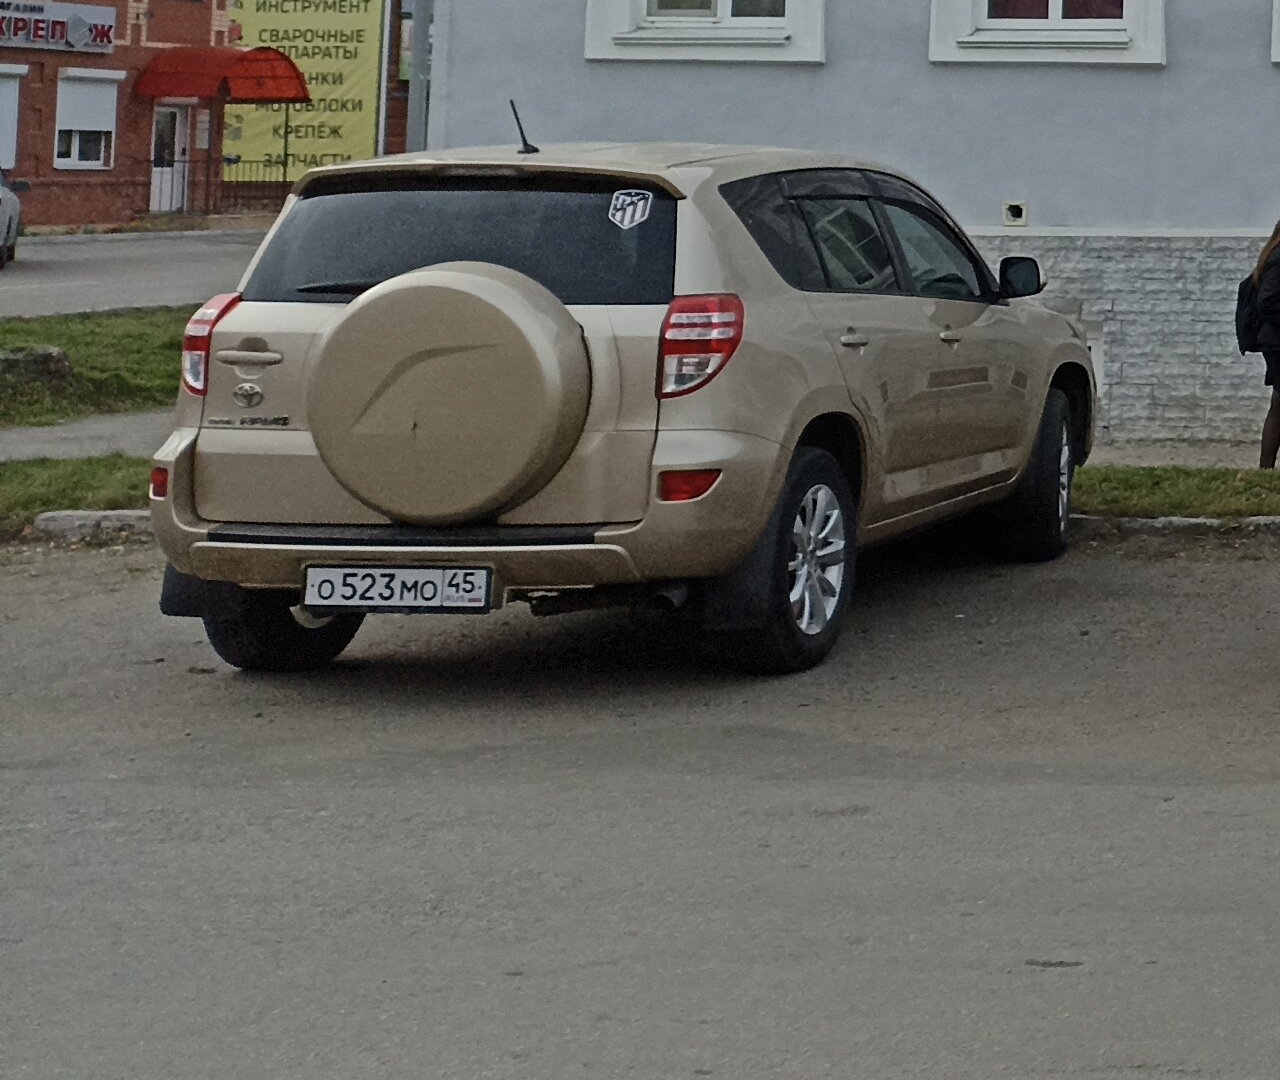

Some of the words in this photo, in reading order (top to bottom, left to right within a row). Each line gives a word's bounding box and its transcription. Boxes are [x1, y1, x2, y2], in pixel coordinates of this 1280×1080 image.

[258, 28, 367, 44] СВАРОЧНЫЕ
[307, 71, 344, 86] НКИ
[446, 571, 476, 594] 45
